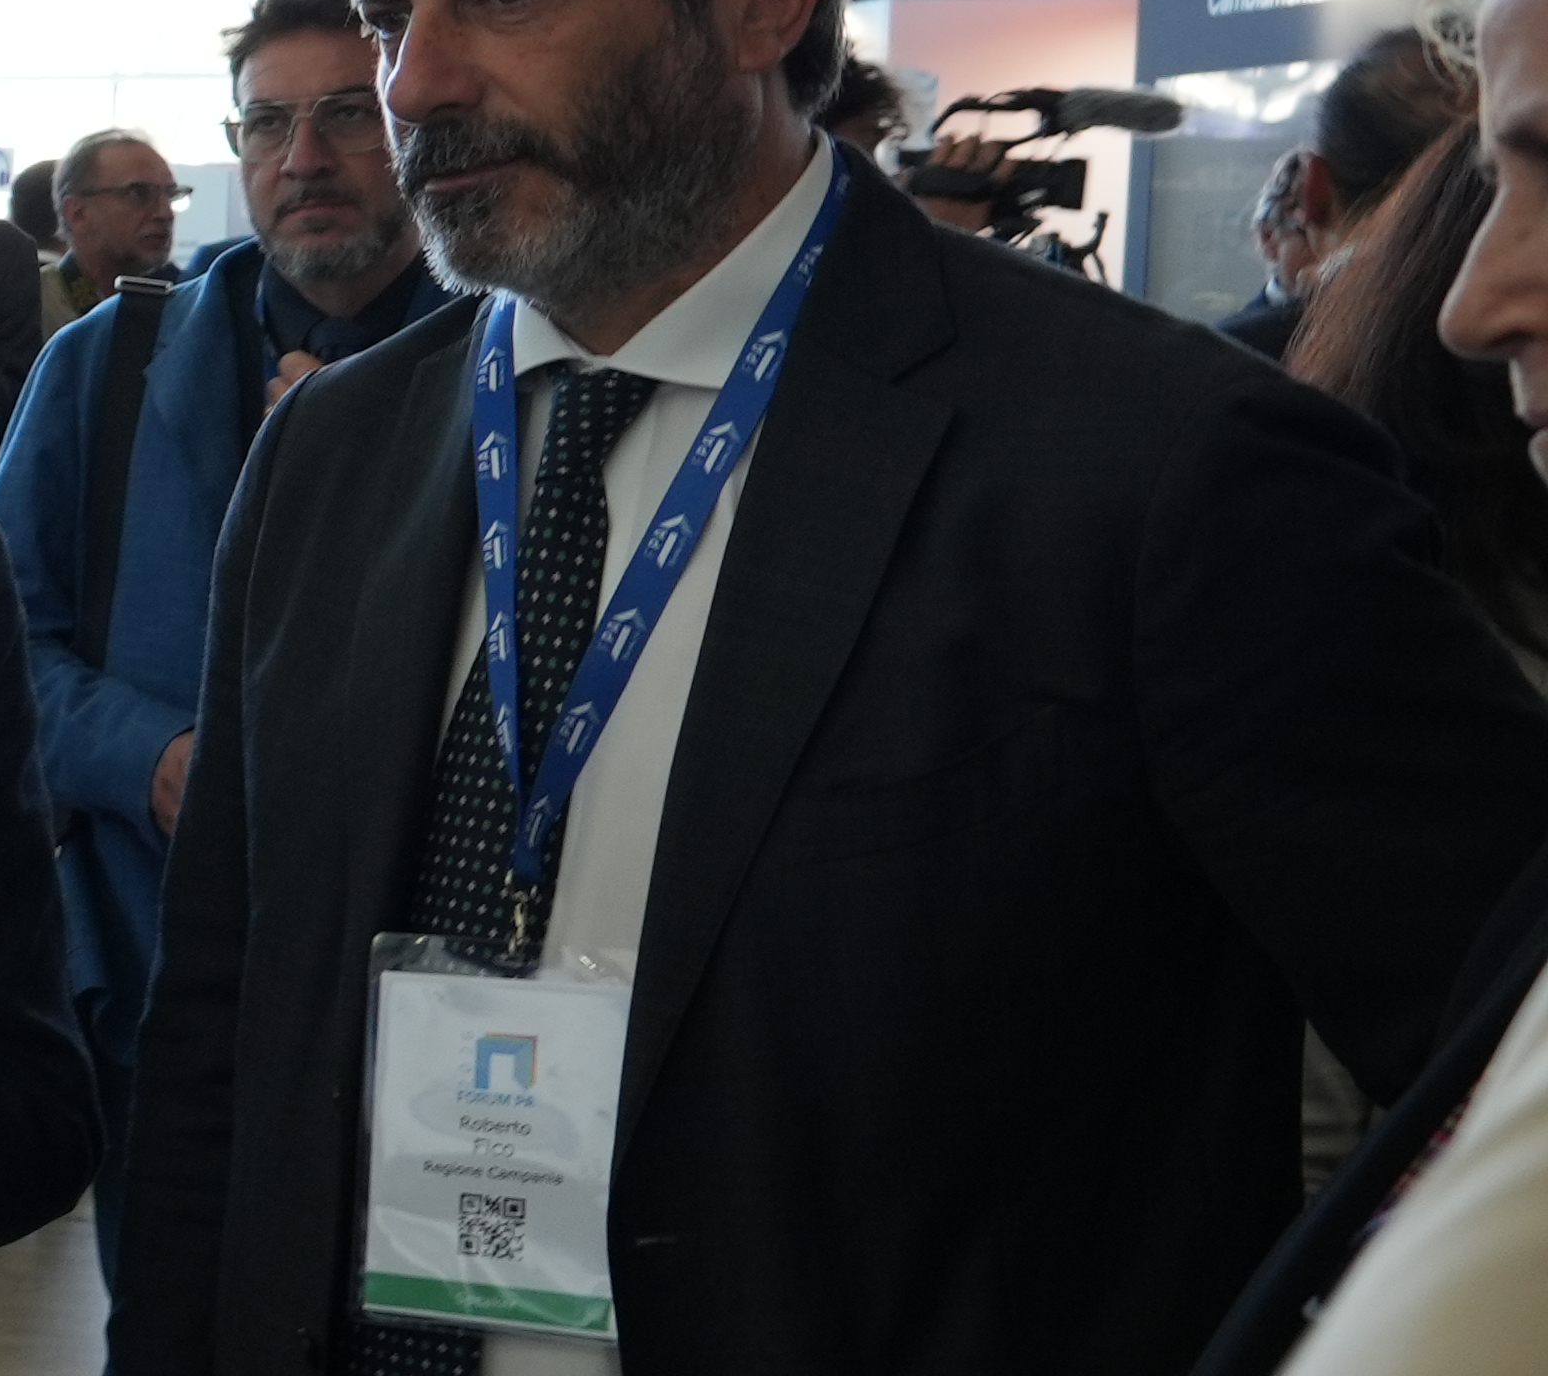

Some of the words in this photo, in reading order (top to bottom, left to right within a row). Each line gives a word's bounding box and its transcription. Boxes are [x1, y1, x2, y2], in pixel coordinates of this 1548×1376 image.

[459, 1114, 532, 1137] Roberto
[473, 1137, 515, 1158] Fico
[423, 1159, 481, 1178] Regione
[487, 1165, 564, 1186] Campania
